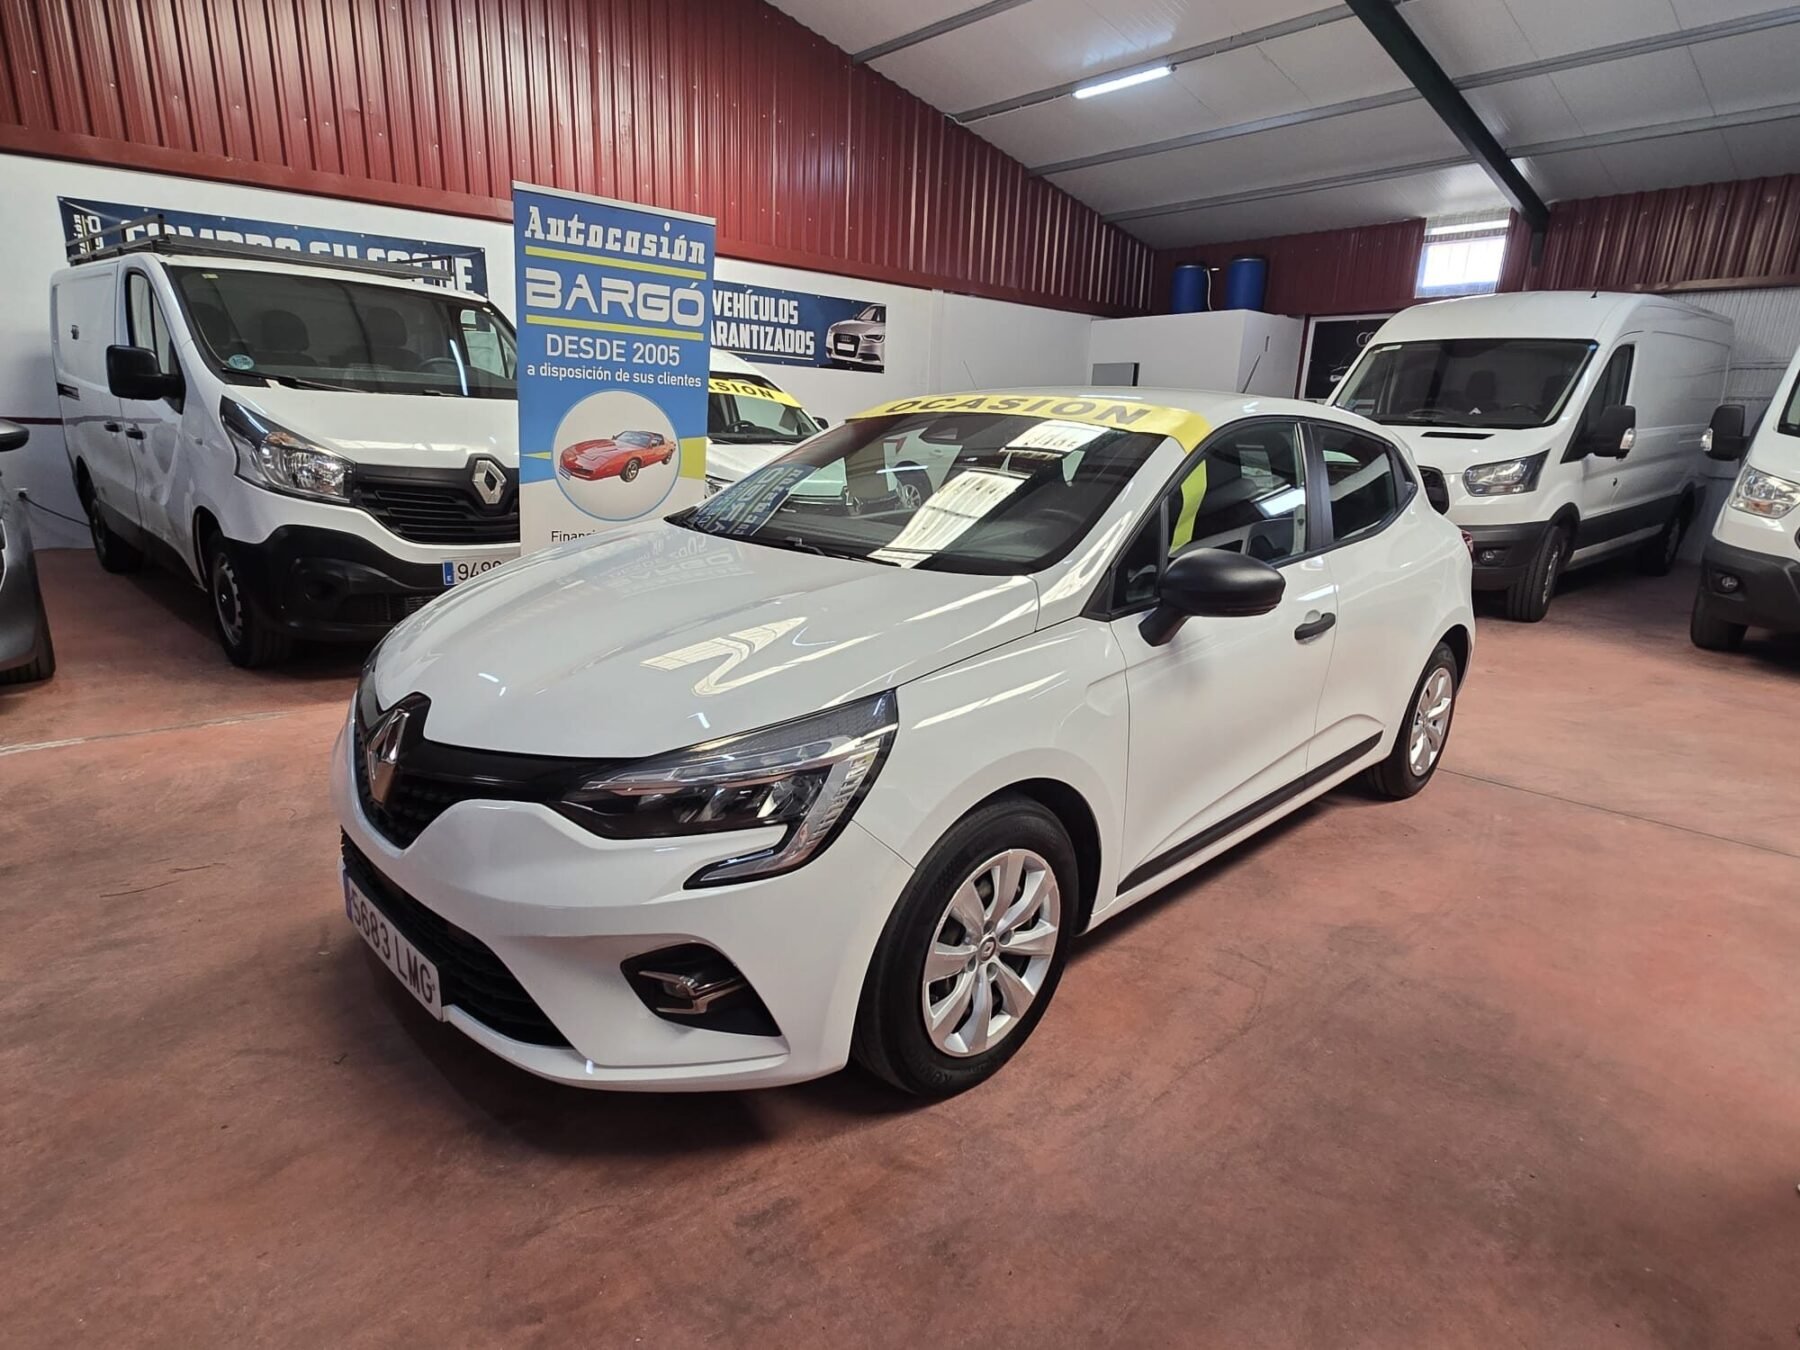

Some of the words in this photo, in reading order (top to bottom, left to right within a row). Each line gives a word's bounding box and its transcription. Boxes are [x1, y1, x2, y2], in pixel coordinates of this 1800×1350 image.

[524, 205, 706, 265] Autocasión
[525, 266, 705, 328] BARGÓ
[712, 289, 800, 325] VEHÍCULOS
[546, 333, 627, 362] DESDE
[632, 342, 681, 367] 2005
[526, 363, 536, 376] a
[539, 362, 612, 382] disposición
[614, 367, 630, 383] de
[632, 371, 655, 385] sus
[657, 371, 703, 388] clientes
[886, 396, 1153, 426] OCASION
[351, 888, 391, 961] 5683
[394, 935, 435, 1005] LMG
